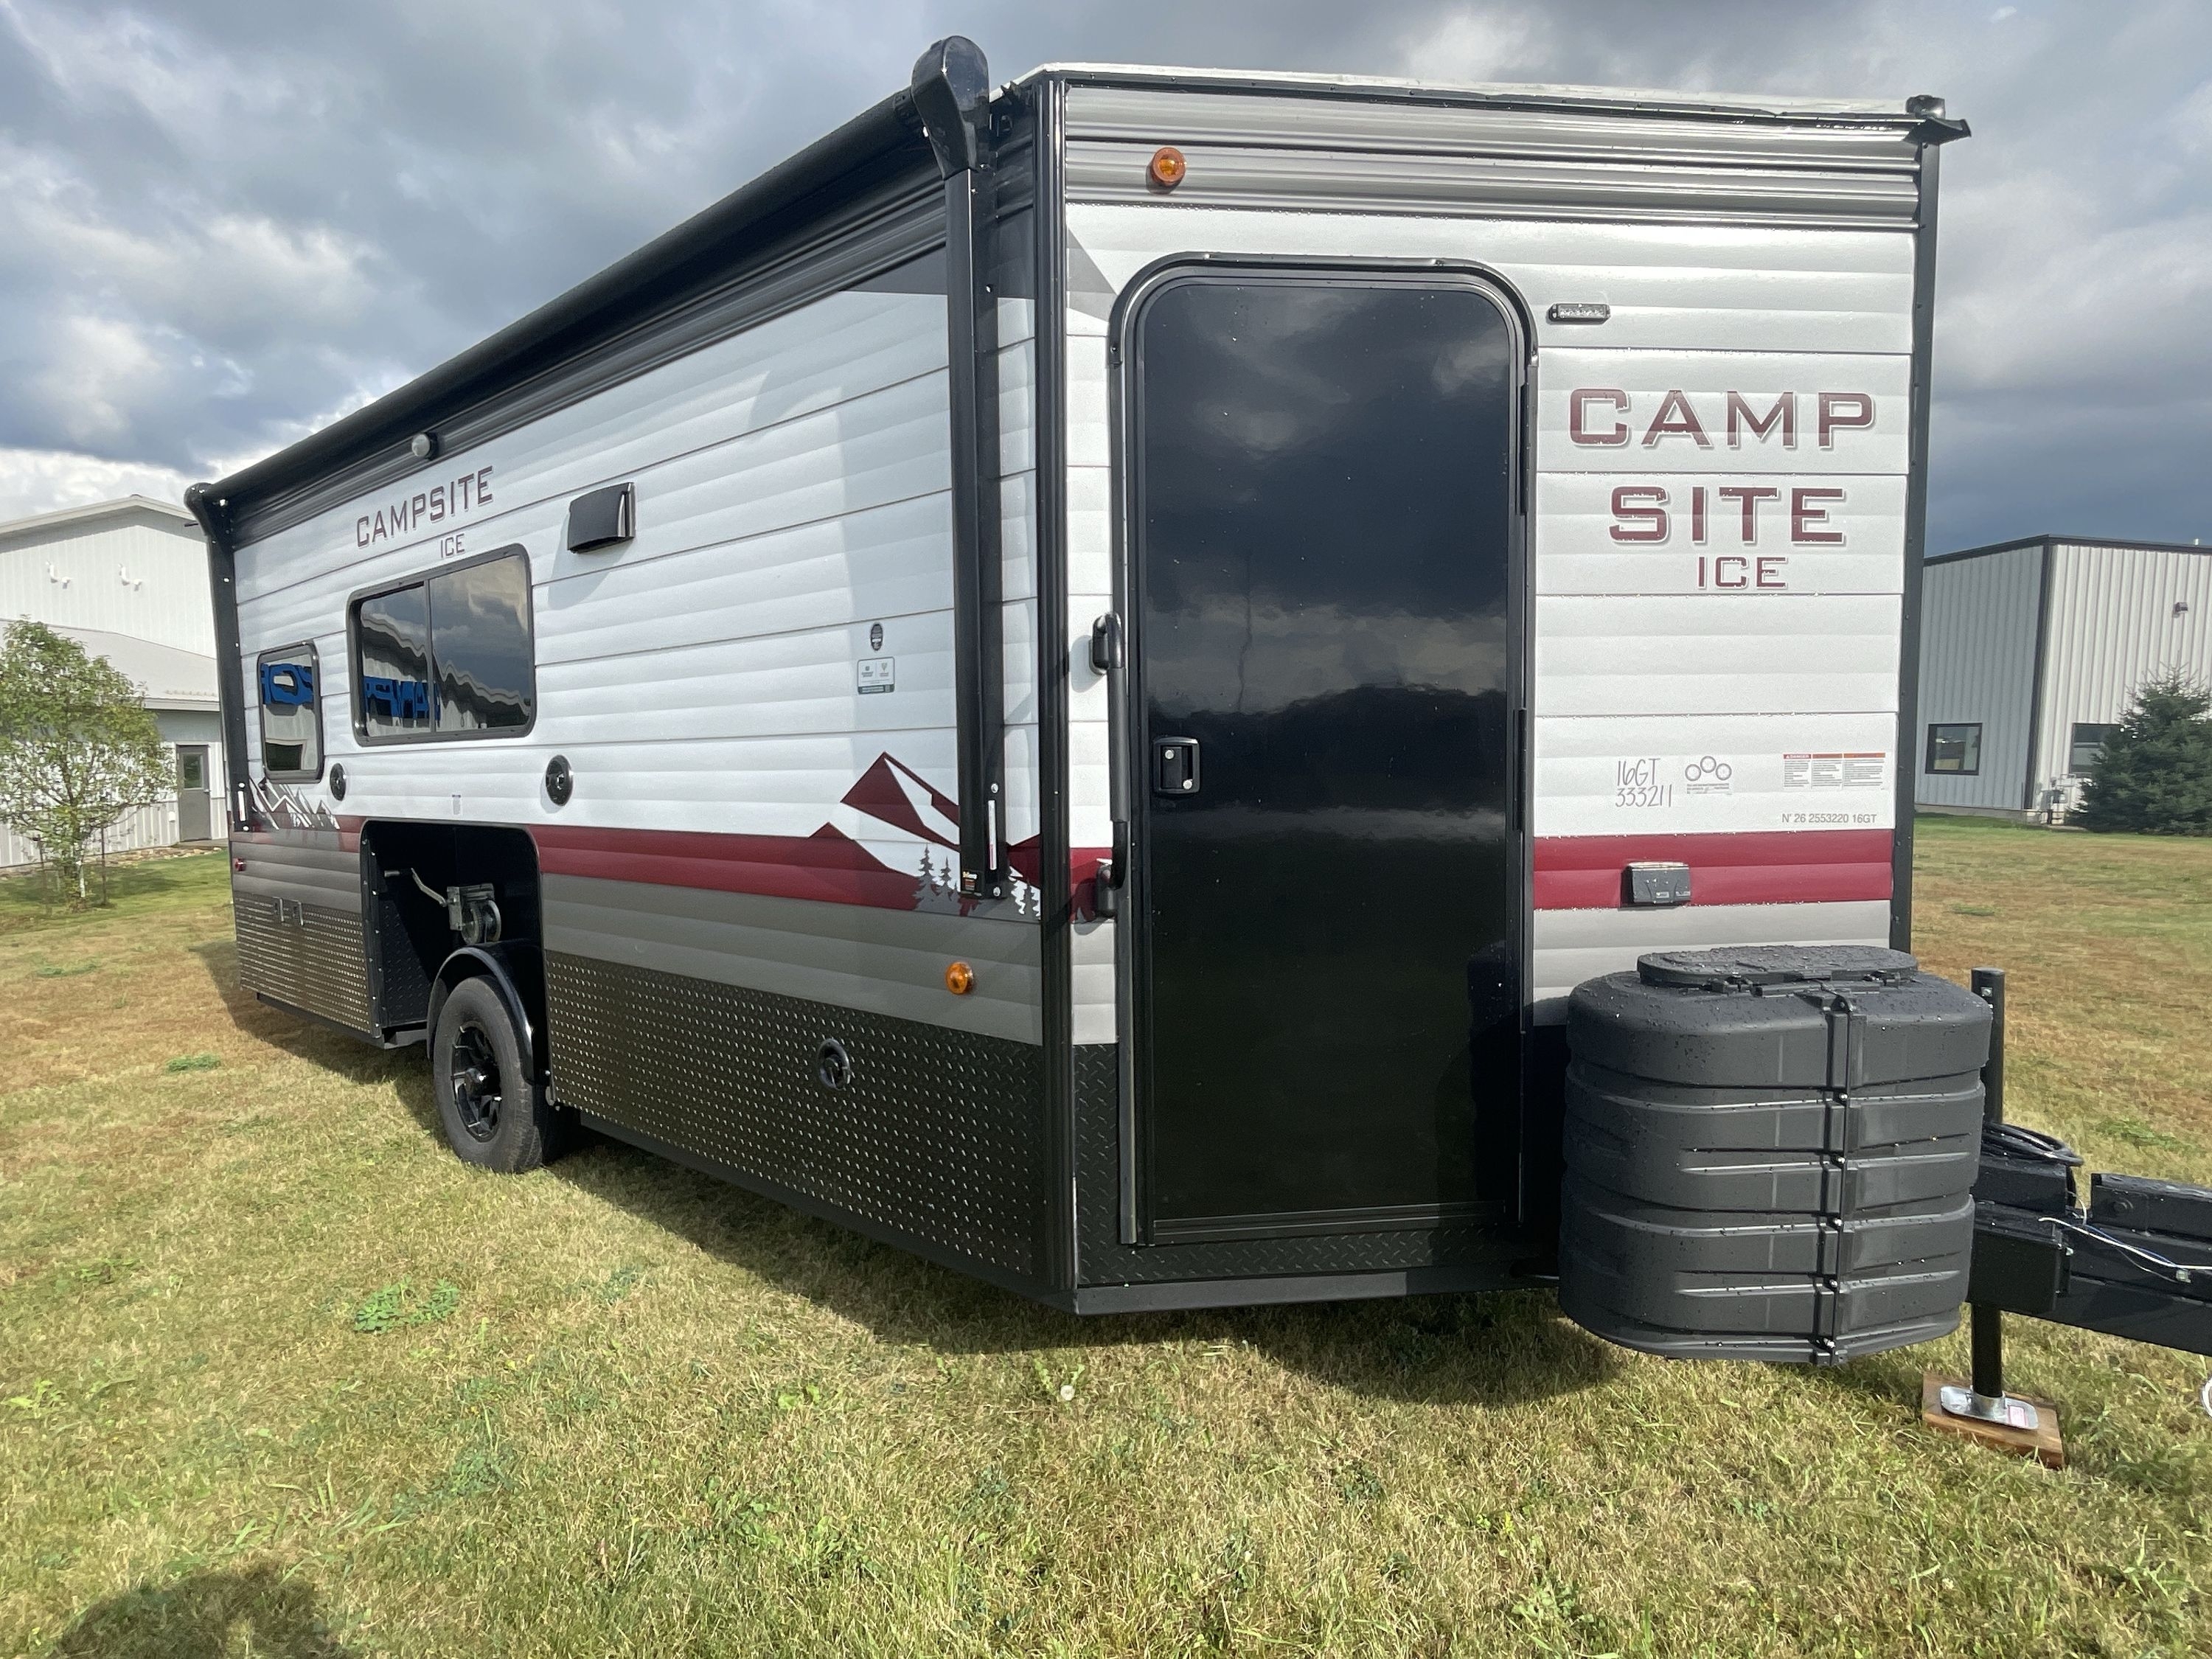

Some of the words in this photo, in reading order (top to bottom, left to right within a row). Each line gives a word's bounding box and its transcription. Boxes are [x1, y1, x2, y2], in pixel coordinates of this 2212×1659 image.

[1570, 389, 1875, 448] CAMP
[357, 465, 493, 548] CAMPSITE
[1609, 486, 1846, 544] SITE
[440, 533, 465, 558] ICE
[1698, 556, 1788, 588] ICE
[1617, 758, 1660, 787] 16GT
[1794, 813, 1806, 823] 26
[1809, 813, 1849, 823] 2553220
[1853, 814, 1877, 824] 16GT
